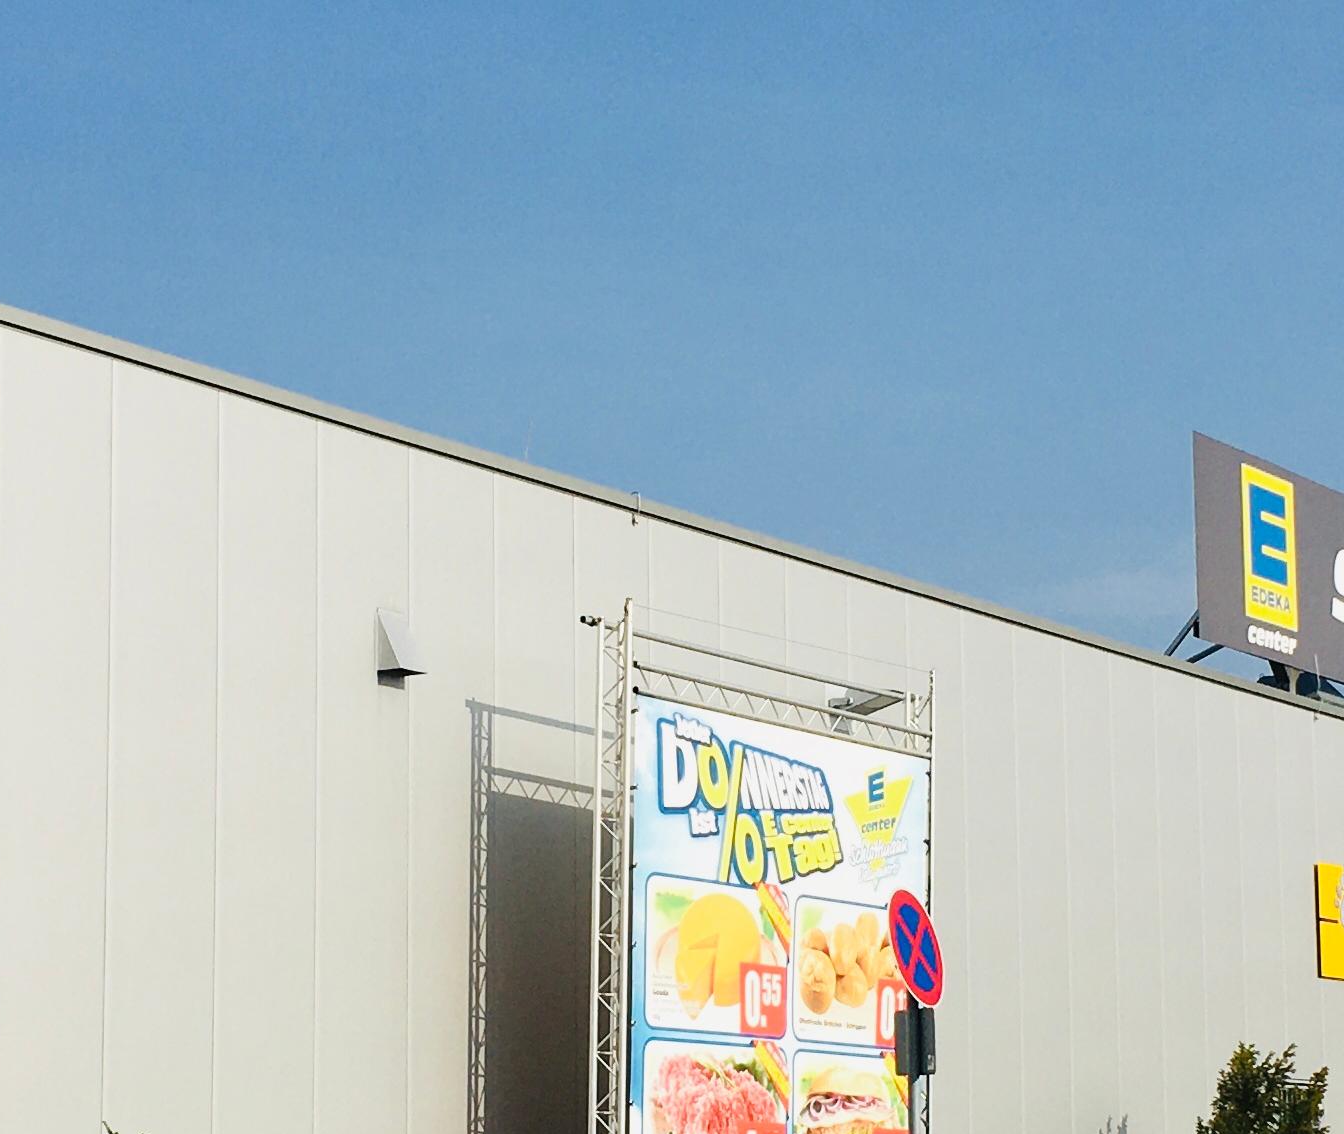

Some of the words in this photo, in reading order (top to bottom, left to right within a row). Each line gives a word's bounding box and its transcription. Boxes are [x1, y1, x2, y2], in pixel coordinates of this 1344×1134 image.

[1251, 585, 1291, 613] EDEKA
[1247, 624, 1297, 655] center
[861, 817, 896, 834] center
[764, 831, 842, 883] Tag!
[744, 969, 782, 1028] 0.55
